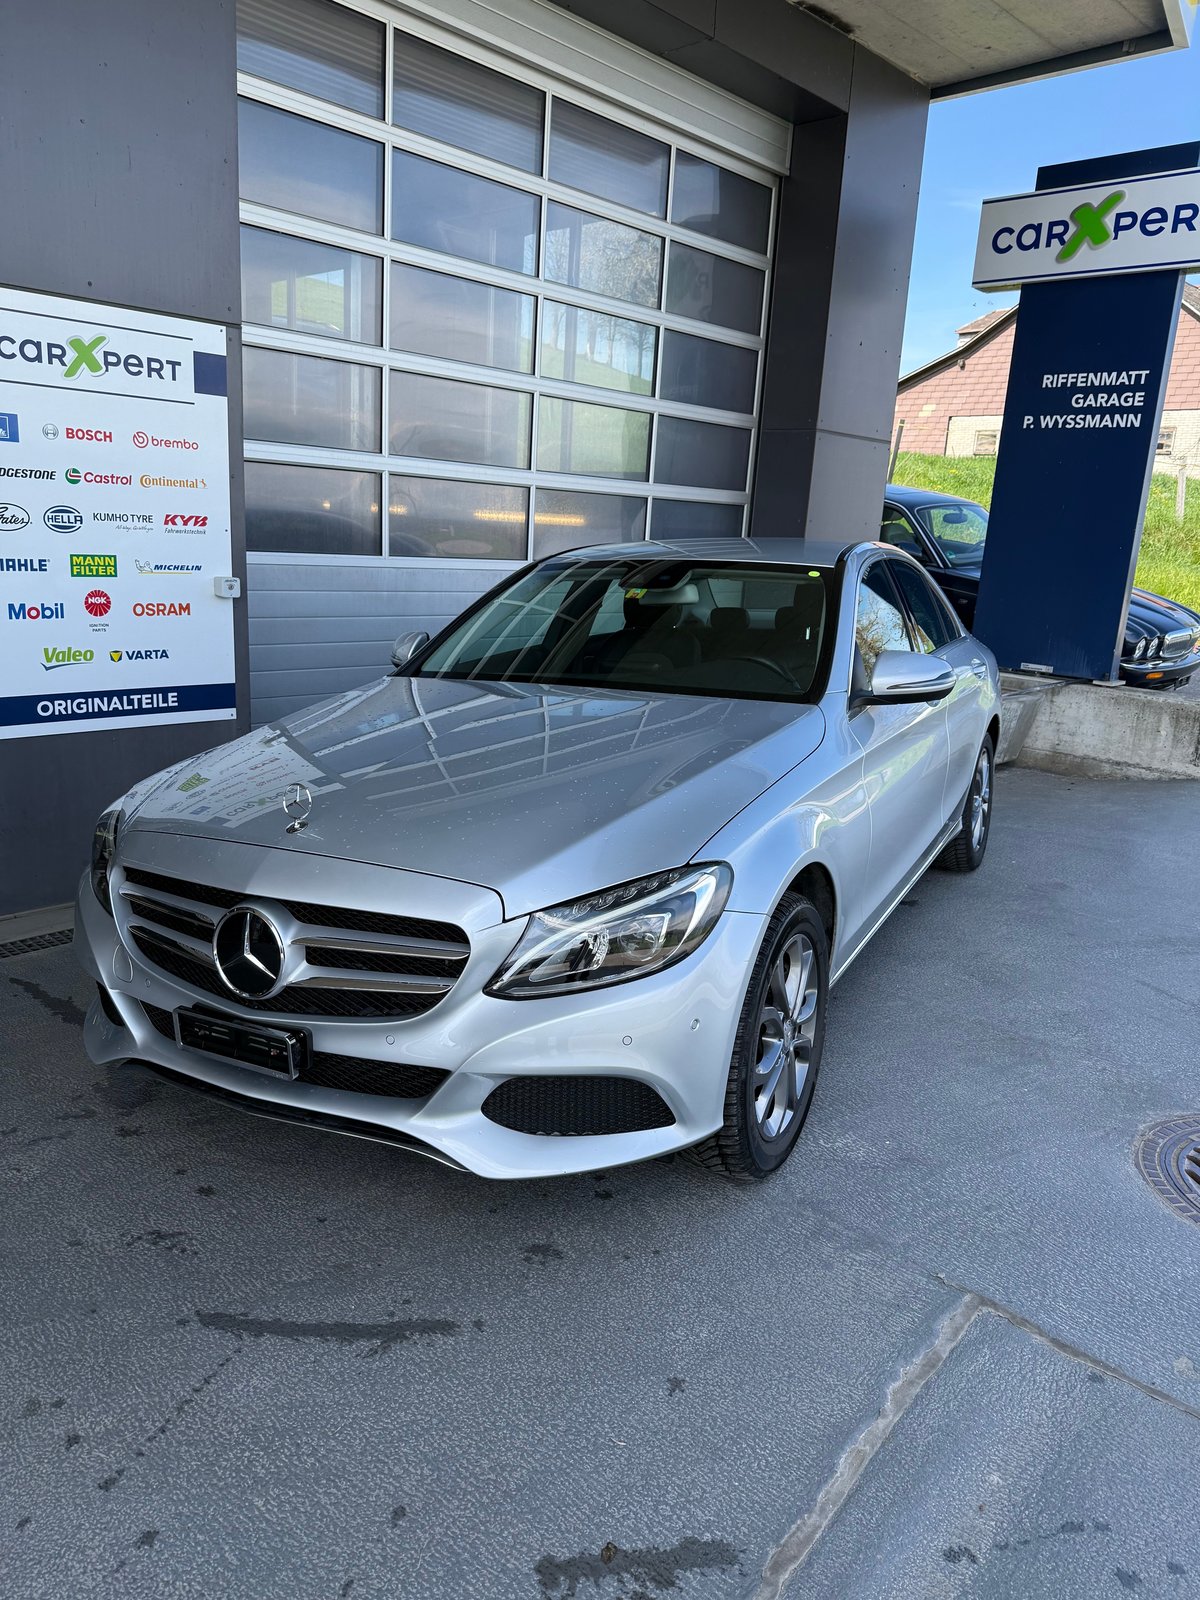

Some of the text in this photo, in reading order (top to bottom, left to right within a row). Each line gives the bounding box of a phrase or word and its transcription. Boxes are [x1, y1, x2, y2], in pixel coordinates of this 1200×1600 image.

[1042, 370, 1150, 388] RIFFENMATT
[1071, 392, 1145, 408] GARAGE
[1023, 413, 1142, 429] P. WYSSMANN
[65, 427, 113, 443] BOSCH
[151, 436, 199, 450] brembo
[83, 471, 133, 486] Castrol
[140, 474, 199, 489] Continental
[47, 514, 83, 525] HELLA
[93, 512, 154, 524] KUMHO TYRE
[163, 513, 209, 527] KYB
[72, 556, 115, 565] MANN
[154, 564, 202, 572] MICHELIN
[73, 566, 115, 576] FILTER
[8, 602, 65, 620] Mobil
[132, 602, 191, 617] OSRAM
[43, 647, 95, 663] Valeo
[125, 649, 169, 661] VARTA
[37, 692, 178, 717] ORIGINALTEILE
